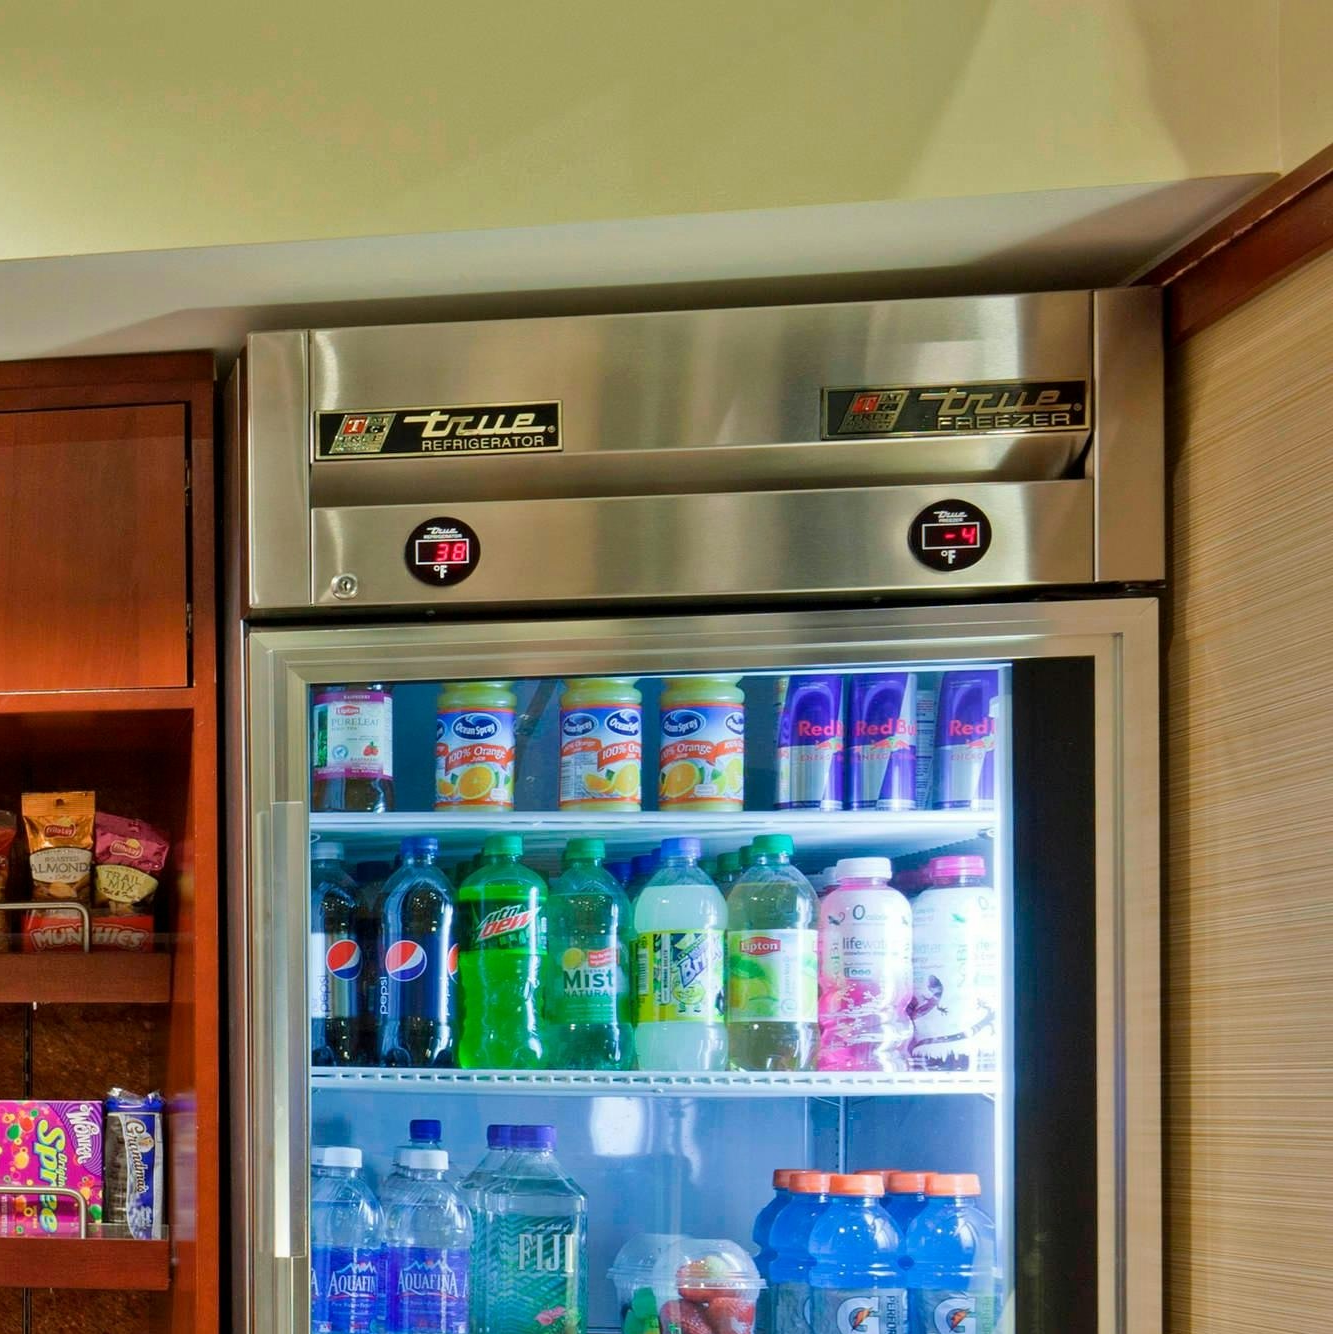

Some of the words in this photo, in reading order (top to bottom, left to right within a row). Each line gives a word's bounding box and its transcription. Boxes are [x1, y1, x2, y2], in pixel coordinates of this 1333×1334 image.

[919, 388, 1072, 415] true
[404, 411, 546, 438] true
[938, 413, 1070, 430] FREEZER
[422, 435, 544, 451] REFRIGERATOR
[945, 527, 976, 544] -4
[437, 543, 466, 561] 38
[455, 722, 476, 734] Ocean
[475, 723, 496, 736] Spray
[798, 721, 832, 736] Red
[856, 719, 893, 736] Red
[950, 720, 988, 736] Red
[449, 749, 470, 762] 100%
[474, 746, 505, 759] Orange
[603, 745, 625, 759] 100%
[677, 744, 712, 755] Orange
[104, 870, 142, 886] TRAIL
[108, 881, 134, 892] MIX
[741, 941, 779, 952] Lipton
[563, 968, 614, 989] Mist
[380, 976, 388, 1015] pepsi
[125, 1119, 150, 1194] Grandma's
[518, 1233, 575, 1276] FIJI
[398, 1270, 459, 1298] AQUAFINA
